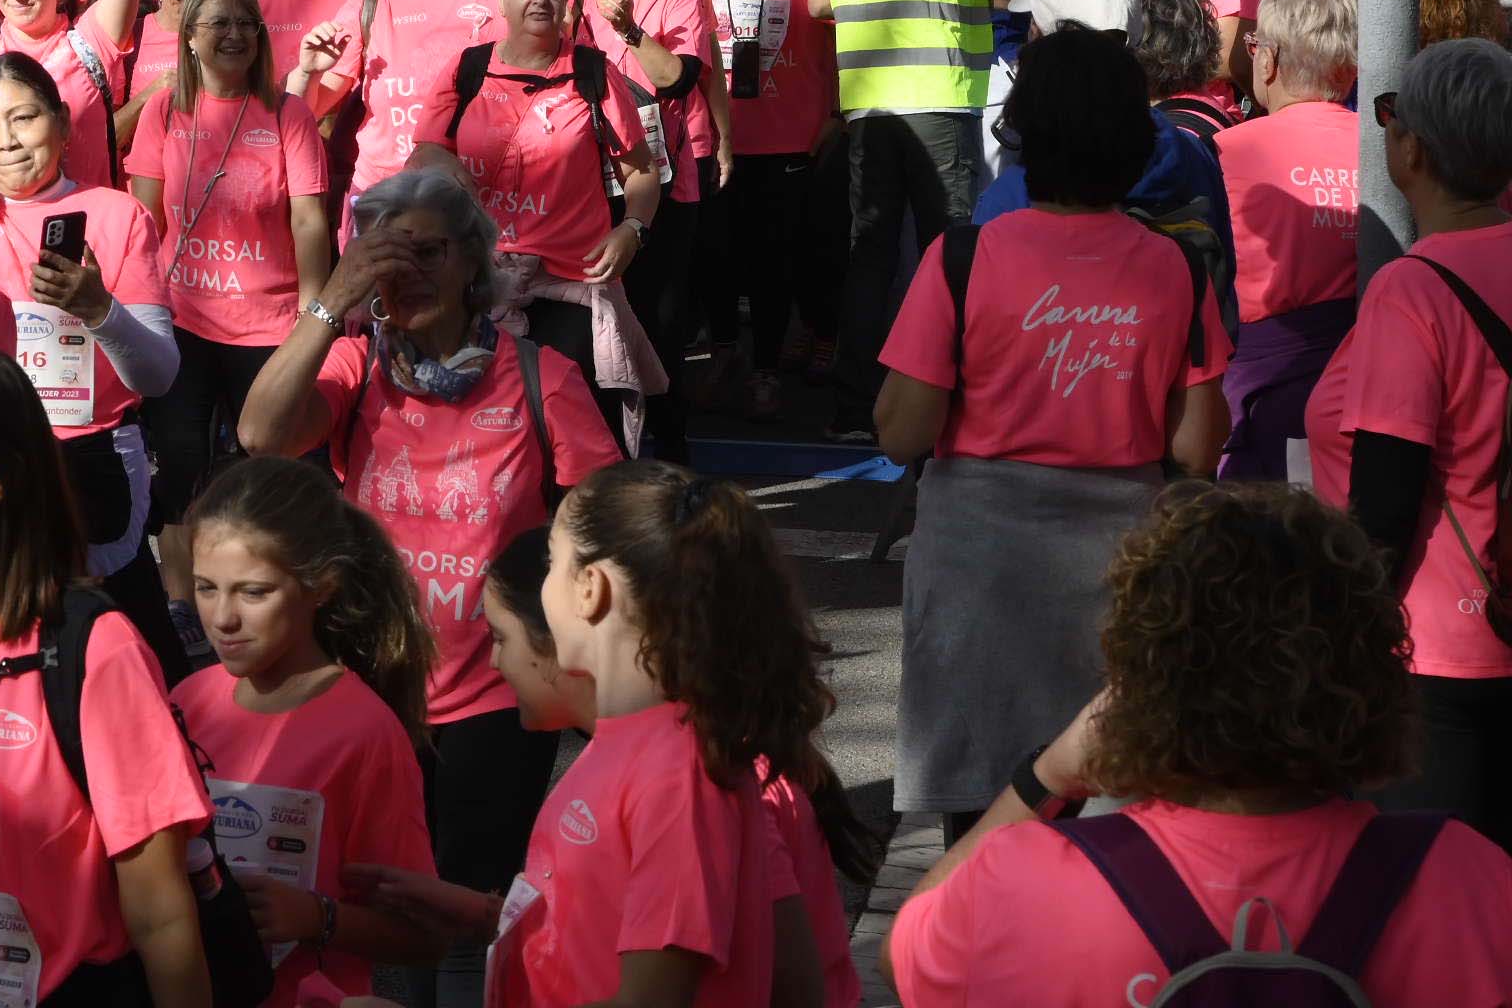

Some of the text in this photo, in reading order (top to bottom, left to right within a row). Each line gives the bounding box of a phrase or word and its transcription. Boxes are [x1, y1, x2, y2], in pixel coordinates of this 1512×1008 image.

[384, 77, 415, 98] TU
[1290, 166, 1358, 189] CARRE
[1314, 187, 1344, 208] DE
[1312, 207, 1357, 229] MUJ
[175, 235, 265, 262] DORSAL
[170, 262, 243, 293] SUMA
[1022, 283, 1144, 331] Carrera
[17, 351, 47, 368] 16
[1039, 329, 1118, 398] Mujer
[39, 390, 59, 398] UJER
